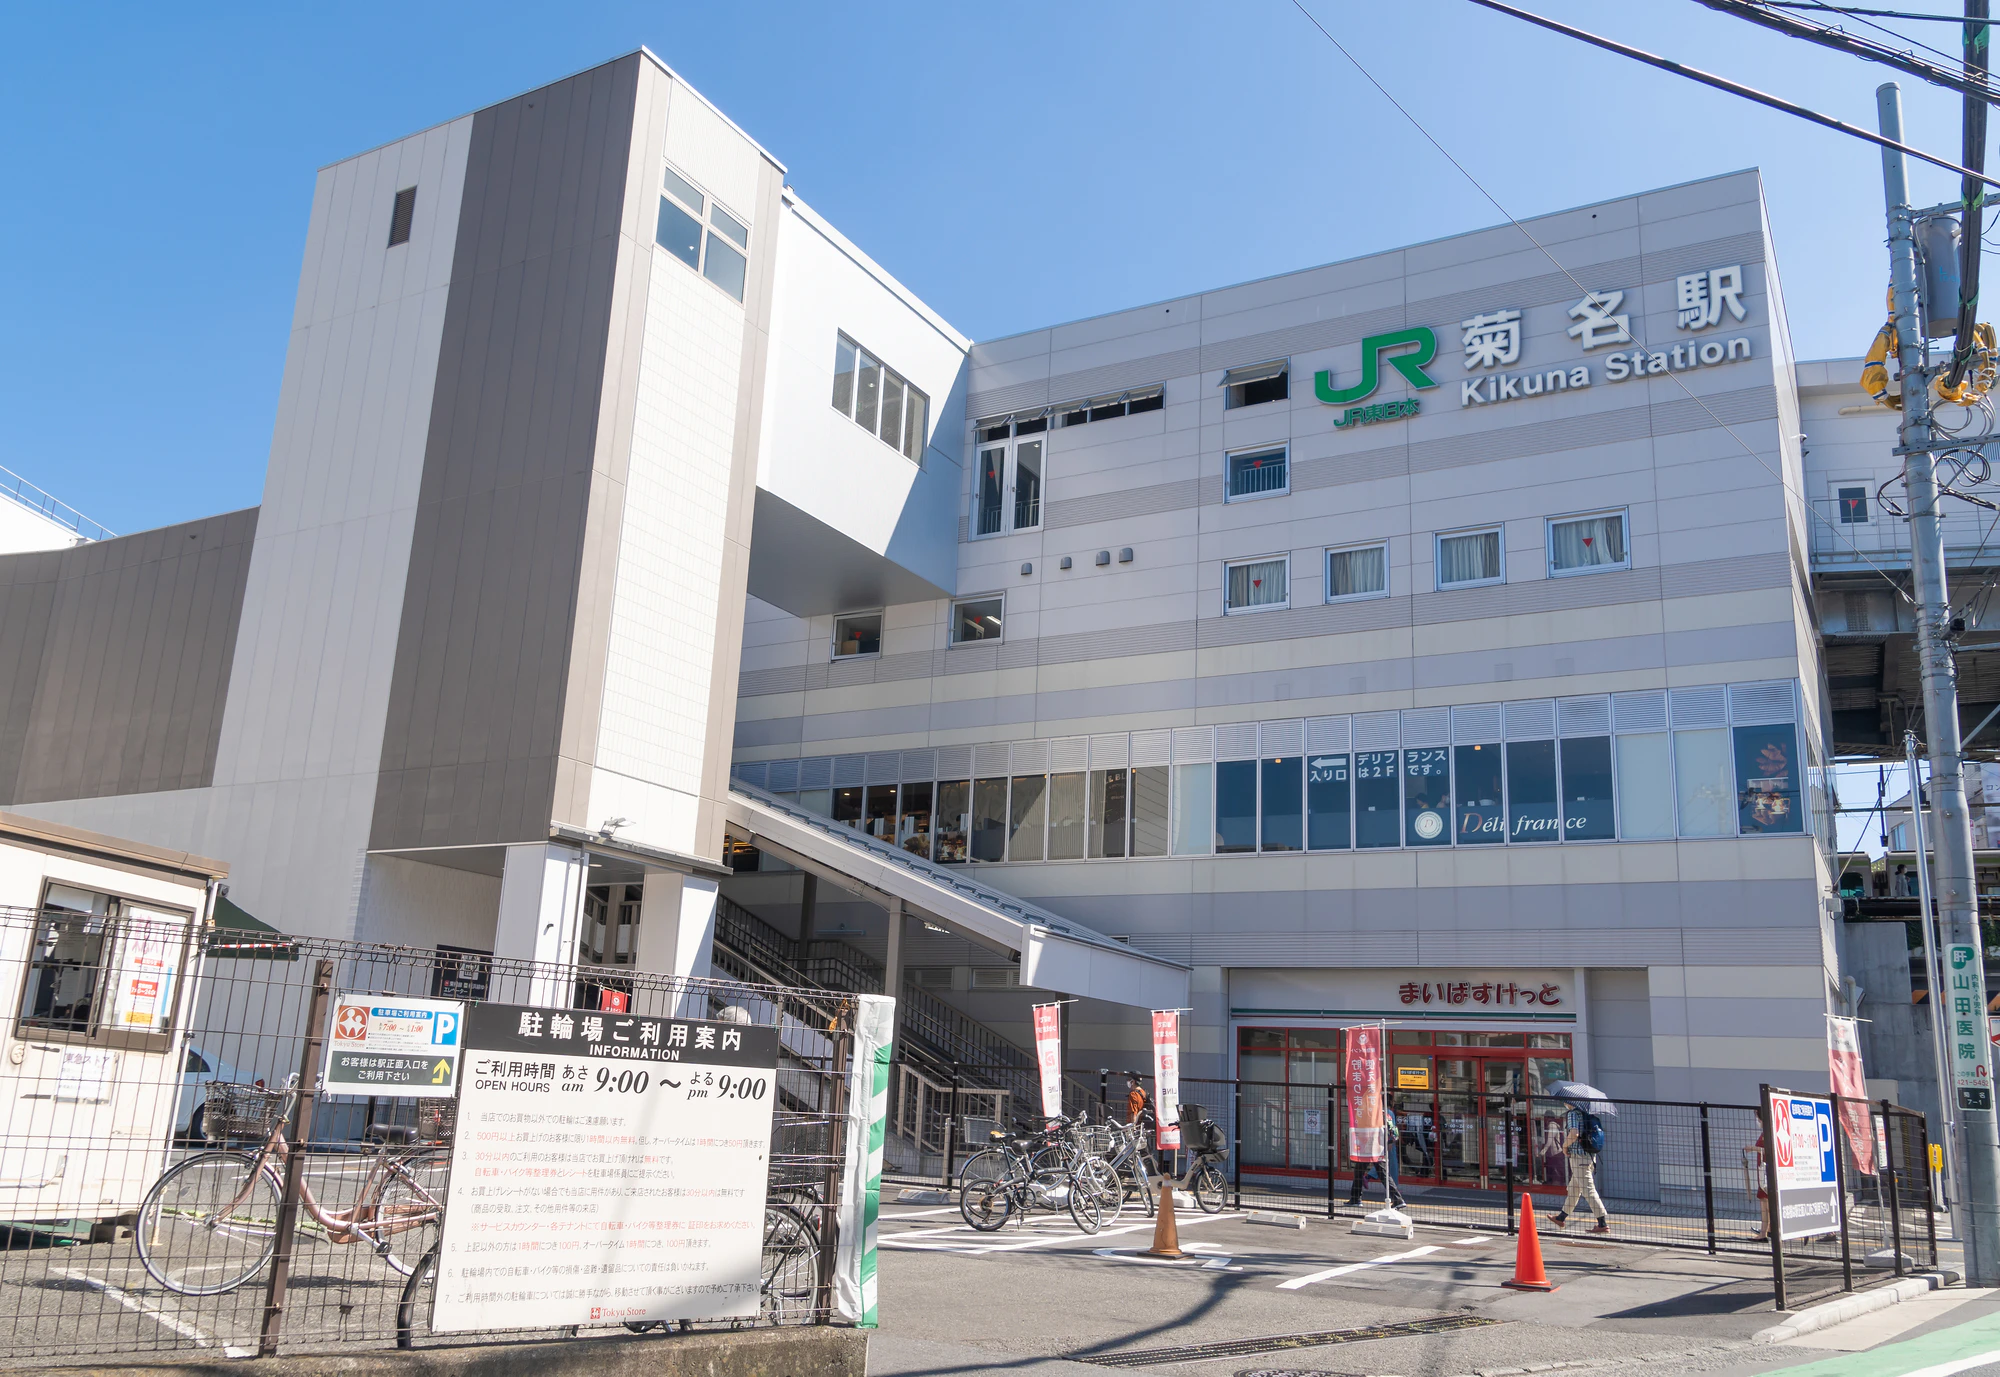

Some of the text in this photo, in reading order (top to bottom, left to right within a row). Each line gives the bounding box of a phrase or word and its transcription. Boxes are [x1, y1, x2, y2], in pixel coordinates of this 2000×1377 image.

[1460, 264, 1748, 371] 菊名駅
[1314, 325, 1439, 404] JR
[1461, 335, 1752, 408] Kikuna Station
[1332, 397, 1420, 427] JR東日本
[1310, 769, 1347, 782] 入り口
[1459, 812, 1588, 836] Déli france
[1953, 950, 1967, 962] 肝
[1398, 982, 1561, 1006] まいばすけっと
[1971, 973, 1982, 1017] 内科・小児科
[1952, 973, 1976, 1060] 山田医院
[382, 1023, 397, 1032] 7:00
[410, 1024, 424, 1033] 1:00
[434, 1013, 455, 1044] P
[517, 1011, 742, 1051] 駐輪場ご利用案内
[589, 1044, 680, 1061] INFORMATION
[340, 1056, 429, 1070] お客様は駅正面入口を
[357, 1070, 410, 1081] ご利用下さい
[475, 1058, 556, 1081] ご利用時間
[562, 1064, 589, 1080] あさ
[594, 1066, 650, 1094] 9:00
[690, 1071, 714, 1086] よる
[716, 1074, 767, 1100] 9:00
[1956, 1079, 1989, 1087] 421-5452
[475, 1079, 709, 1100] OPEN HOURS am pm
[464, 1131, 471, 1140] 2.
[1817, 1113, 1832, 1173] P
[462, 1153, 469, 1161] 3.
[457, 1187, 465, 1196] 4.
[451, 1242, 458, 1252] 5.
[447, 1268, 454, 1278] 6.
[445, 1294, 451, 1304] 7.
[602, 1306, 647, 1319] Tokyu Store
